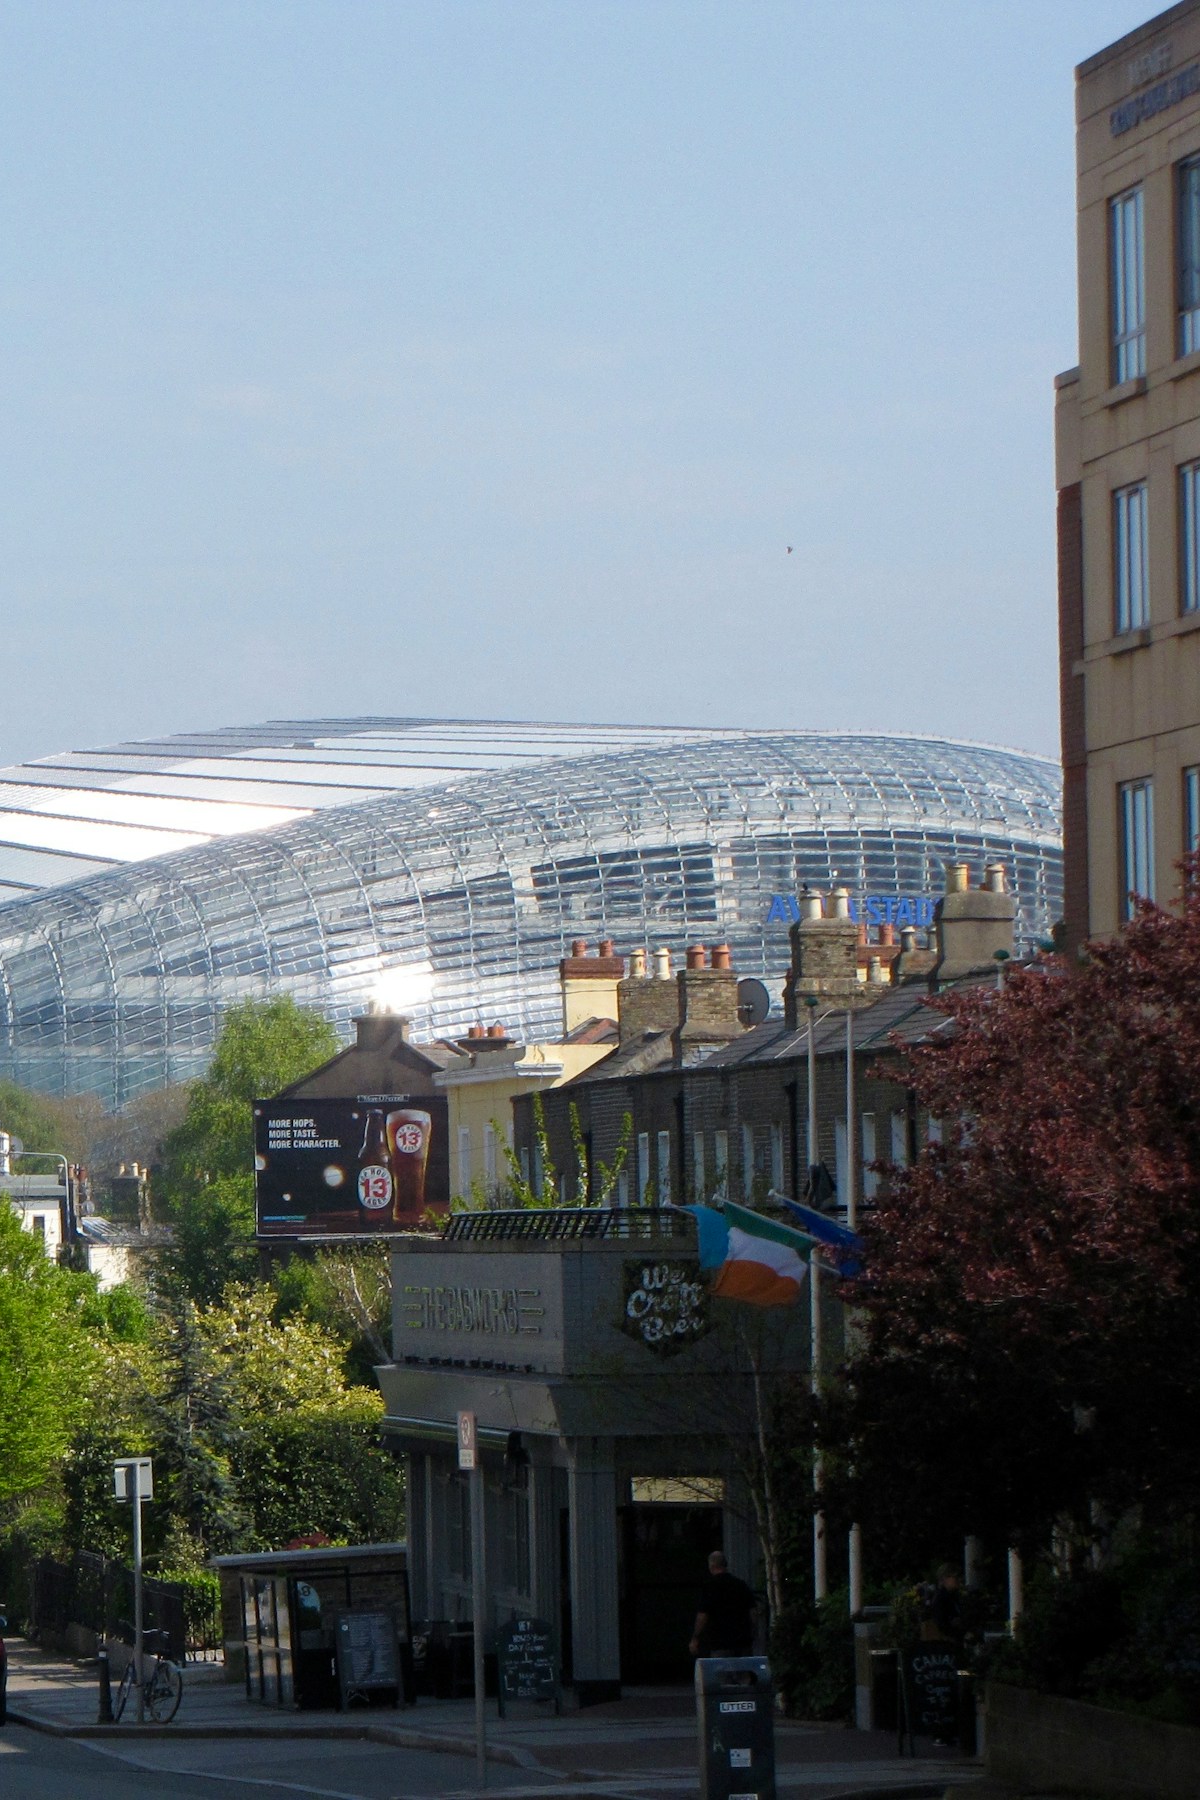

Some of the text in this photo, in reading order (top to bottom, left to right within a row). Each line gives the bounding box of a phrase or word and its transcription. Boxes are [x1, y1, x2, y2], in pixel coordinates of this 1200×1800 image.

[866, 897, 942, 926] STAD
[268, 1118, 316, 1128] MORE HOPS.
[268, 1129, 319, 1138] MORE TASTE.
[399, 1132, 421, 1146] 13
[268, 1139, 341, 1149] MORE CHARACTER.
[360, 1178, 387, 1198] 13
[627, 1282, 704, 1318] Craft
[641, 1317, 704, 1341] Beer
[721, 1702, 754, 1712] LITTER
